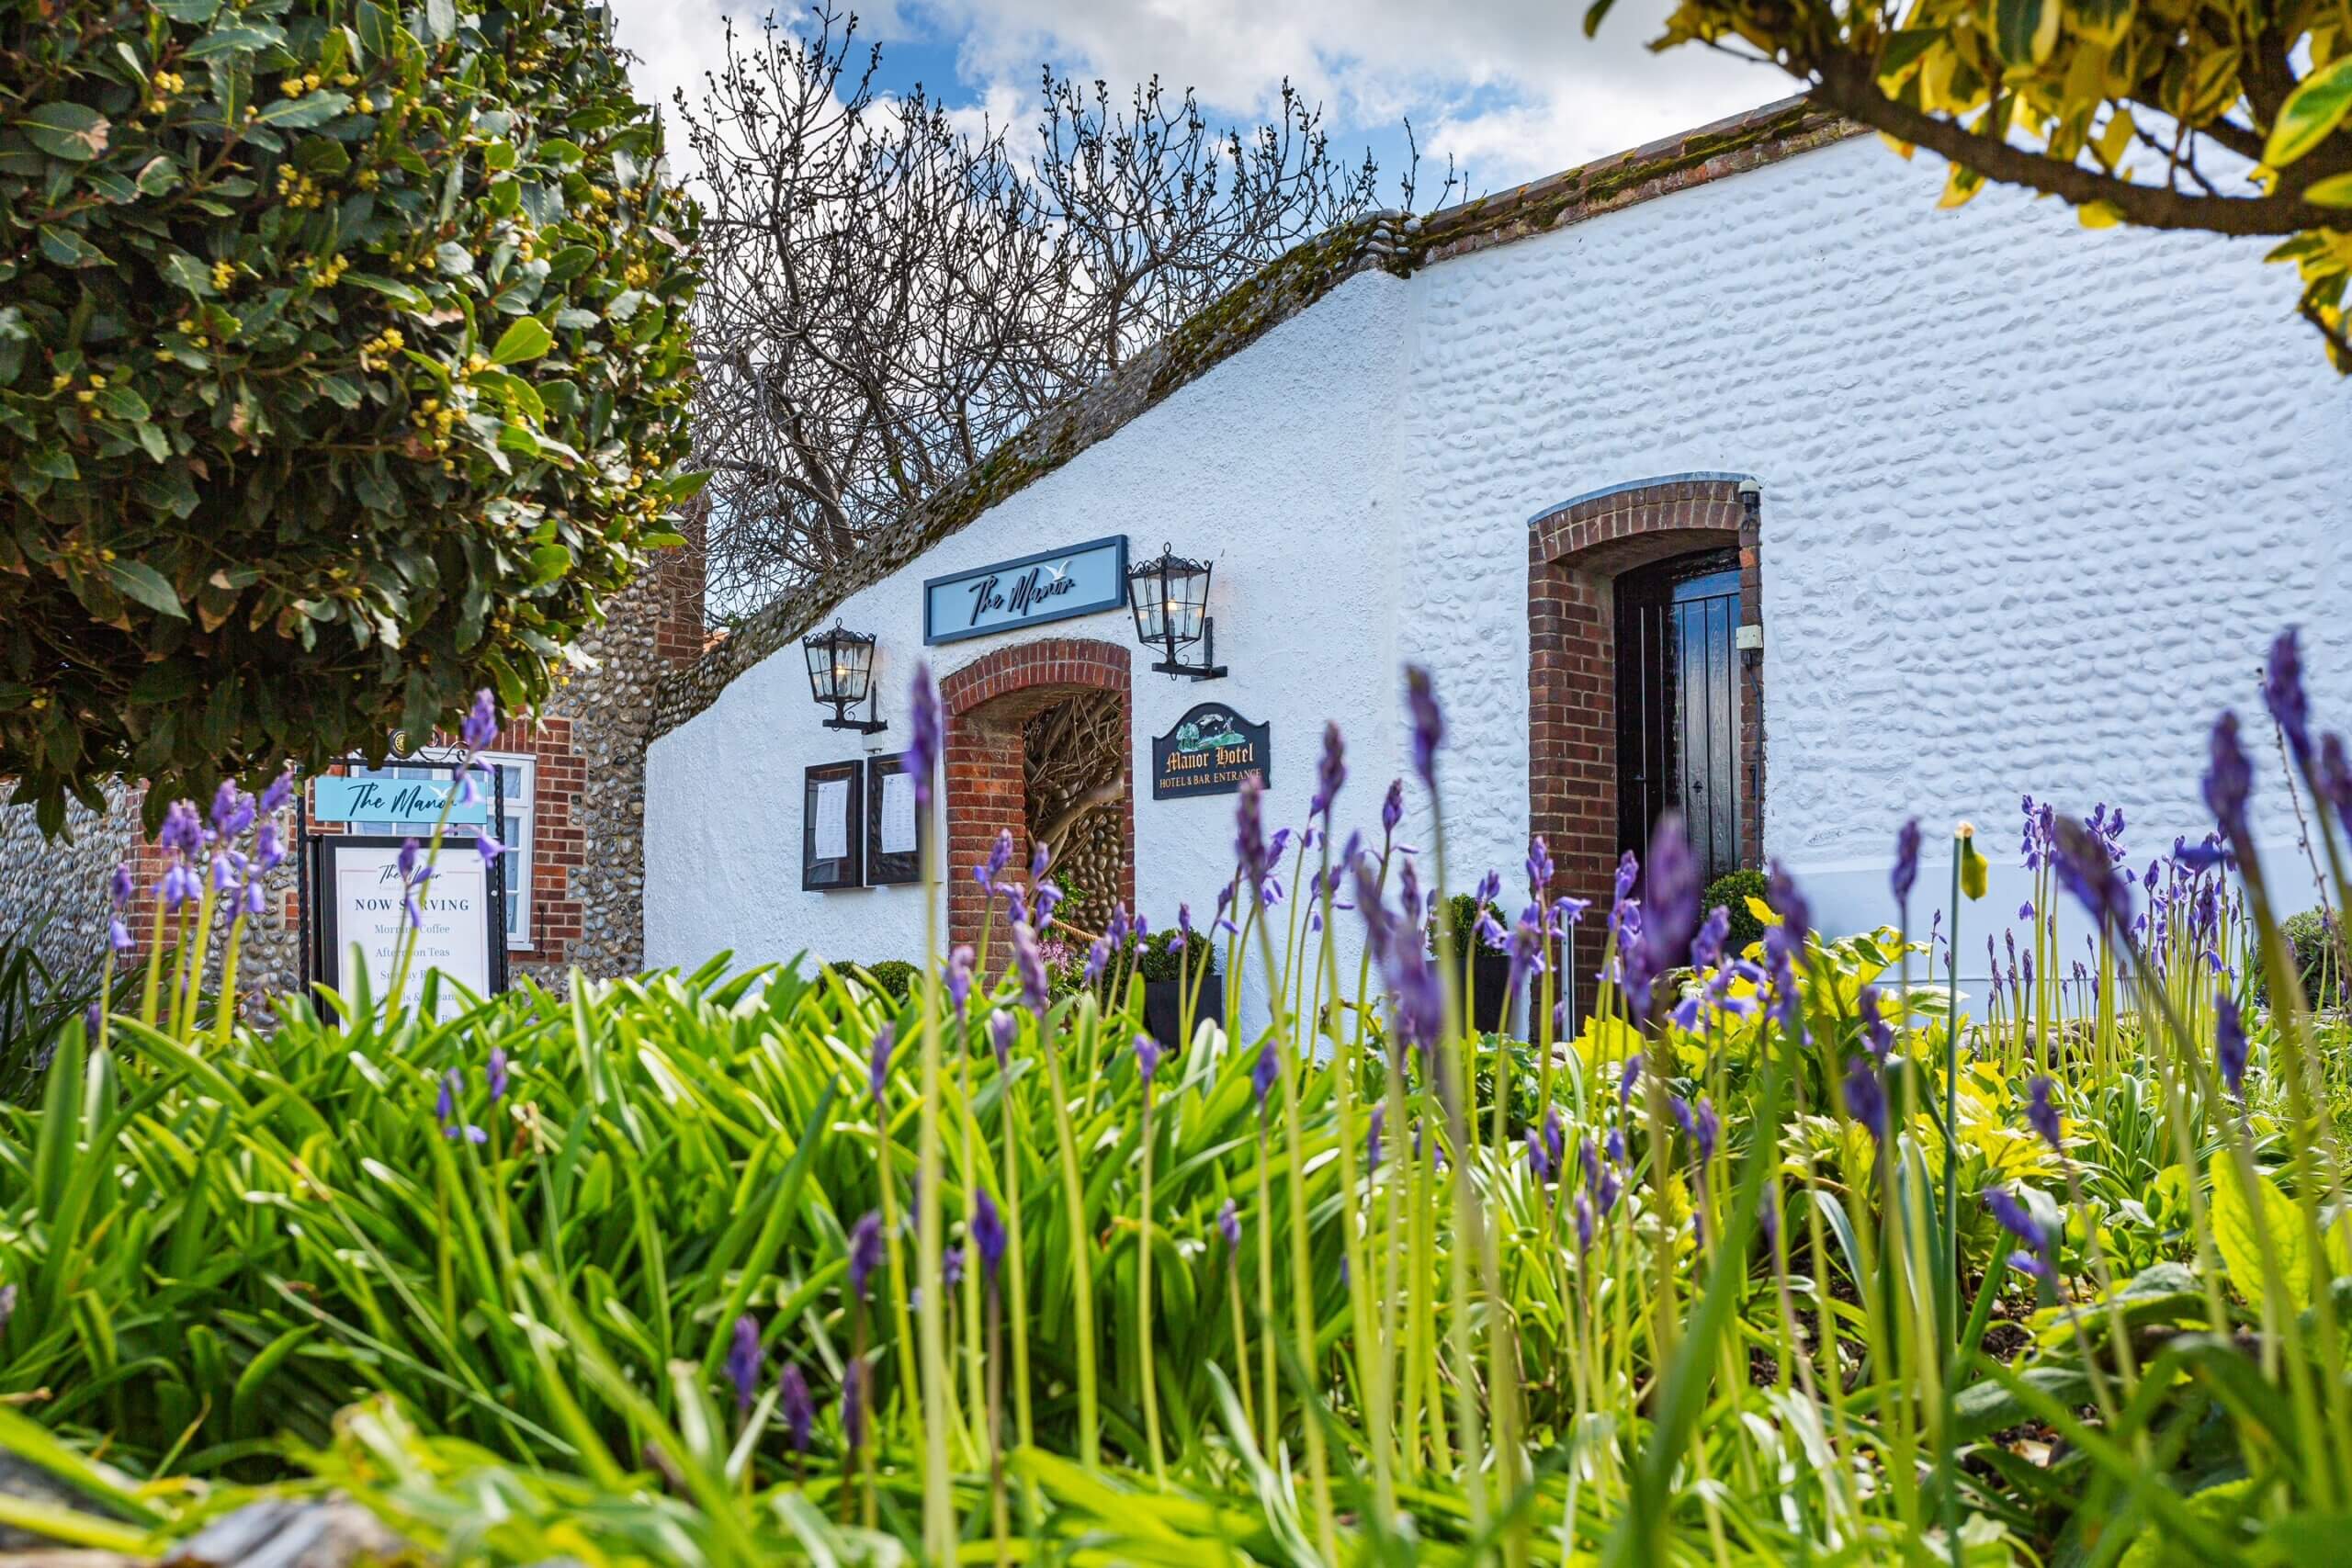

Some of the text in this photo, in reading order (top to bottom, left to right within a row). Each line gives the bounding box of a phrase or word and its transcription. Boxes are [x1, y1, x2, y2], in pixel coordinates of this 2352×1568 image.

[968, 567, 1076, 626] The Manor
[1165, 742, 1254, 773] Manor Hotel
[1159, 777, 1186, 789] HOTEL
[1193, 773, 1211, 785] BAR
[1213, 768, 1261, 783] ENTRANCE
[347, 782, 385, 817] The
[379, 863, 442, 884] The Mor
[355, 898, 469, 911] NOW SRVING
[375, 923, 450, 935] Mornn Coffee
[376, 947, 450, 957] Afternon Teas
